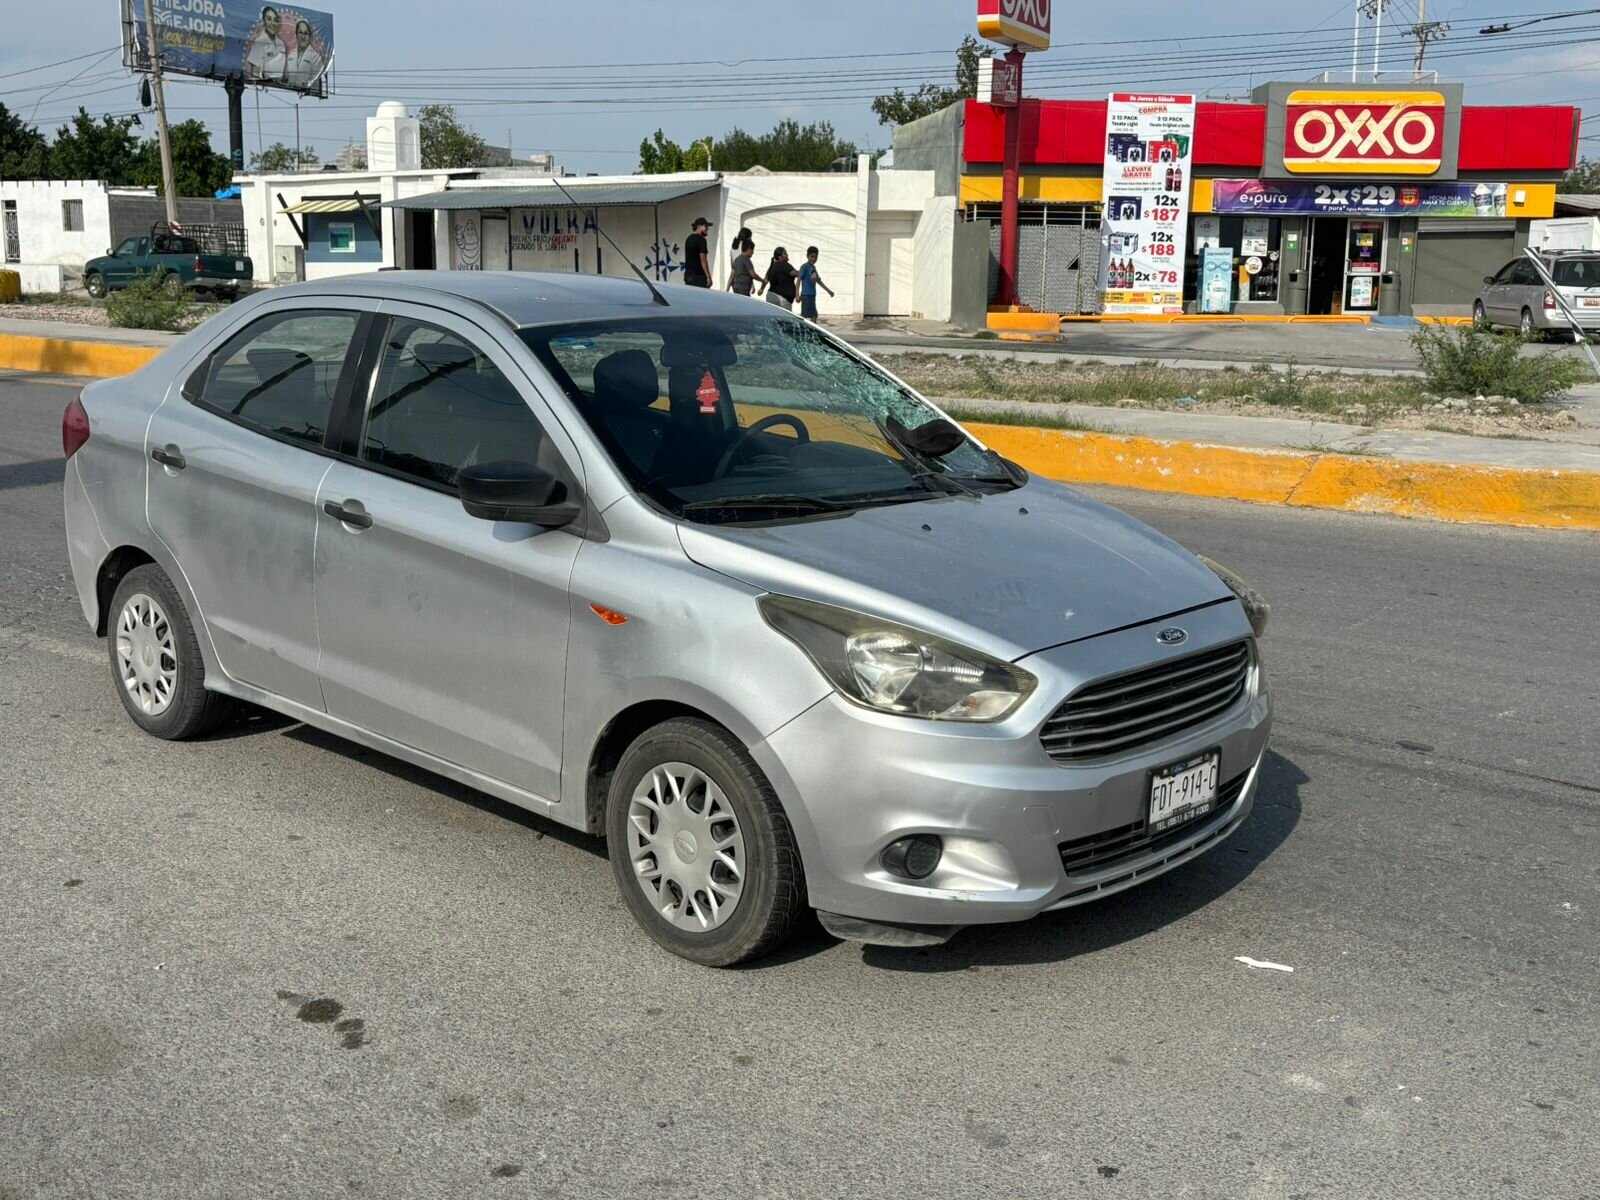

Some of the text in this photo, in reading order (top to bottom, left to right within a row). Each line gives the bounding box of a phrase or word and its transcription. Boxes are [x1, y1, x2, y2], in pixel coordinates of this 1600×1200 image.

[153, 7, 225, 37] MEJORA
[1138, 106, 1168, 114] COMPRA
[1293, 107, 1436, 158] OXXO
[1154, 195, 1178, 206] 12x
[1144, 208, 1180, 221] $187
[521, 209, 597, 234] VULKA
[1151, 231, 1173, 242] 12x
[1141, 244, 1175, 256] $188
[1151, 764, 1216, 814] FDT-914-C
